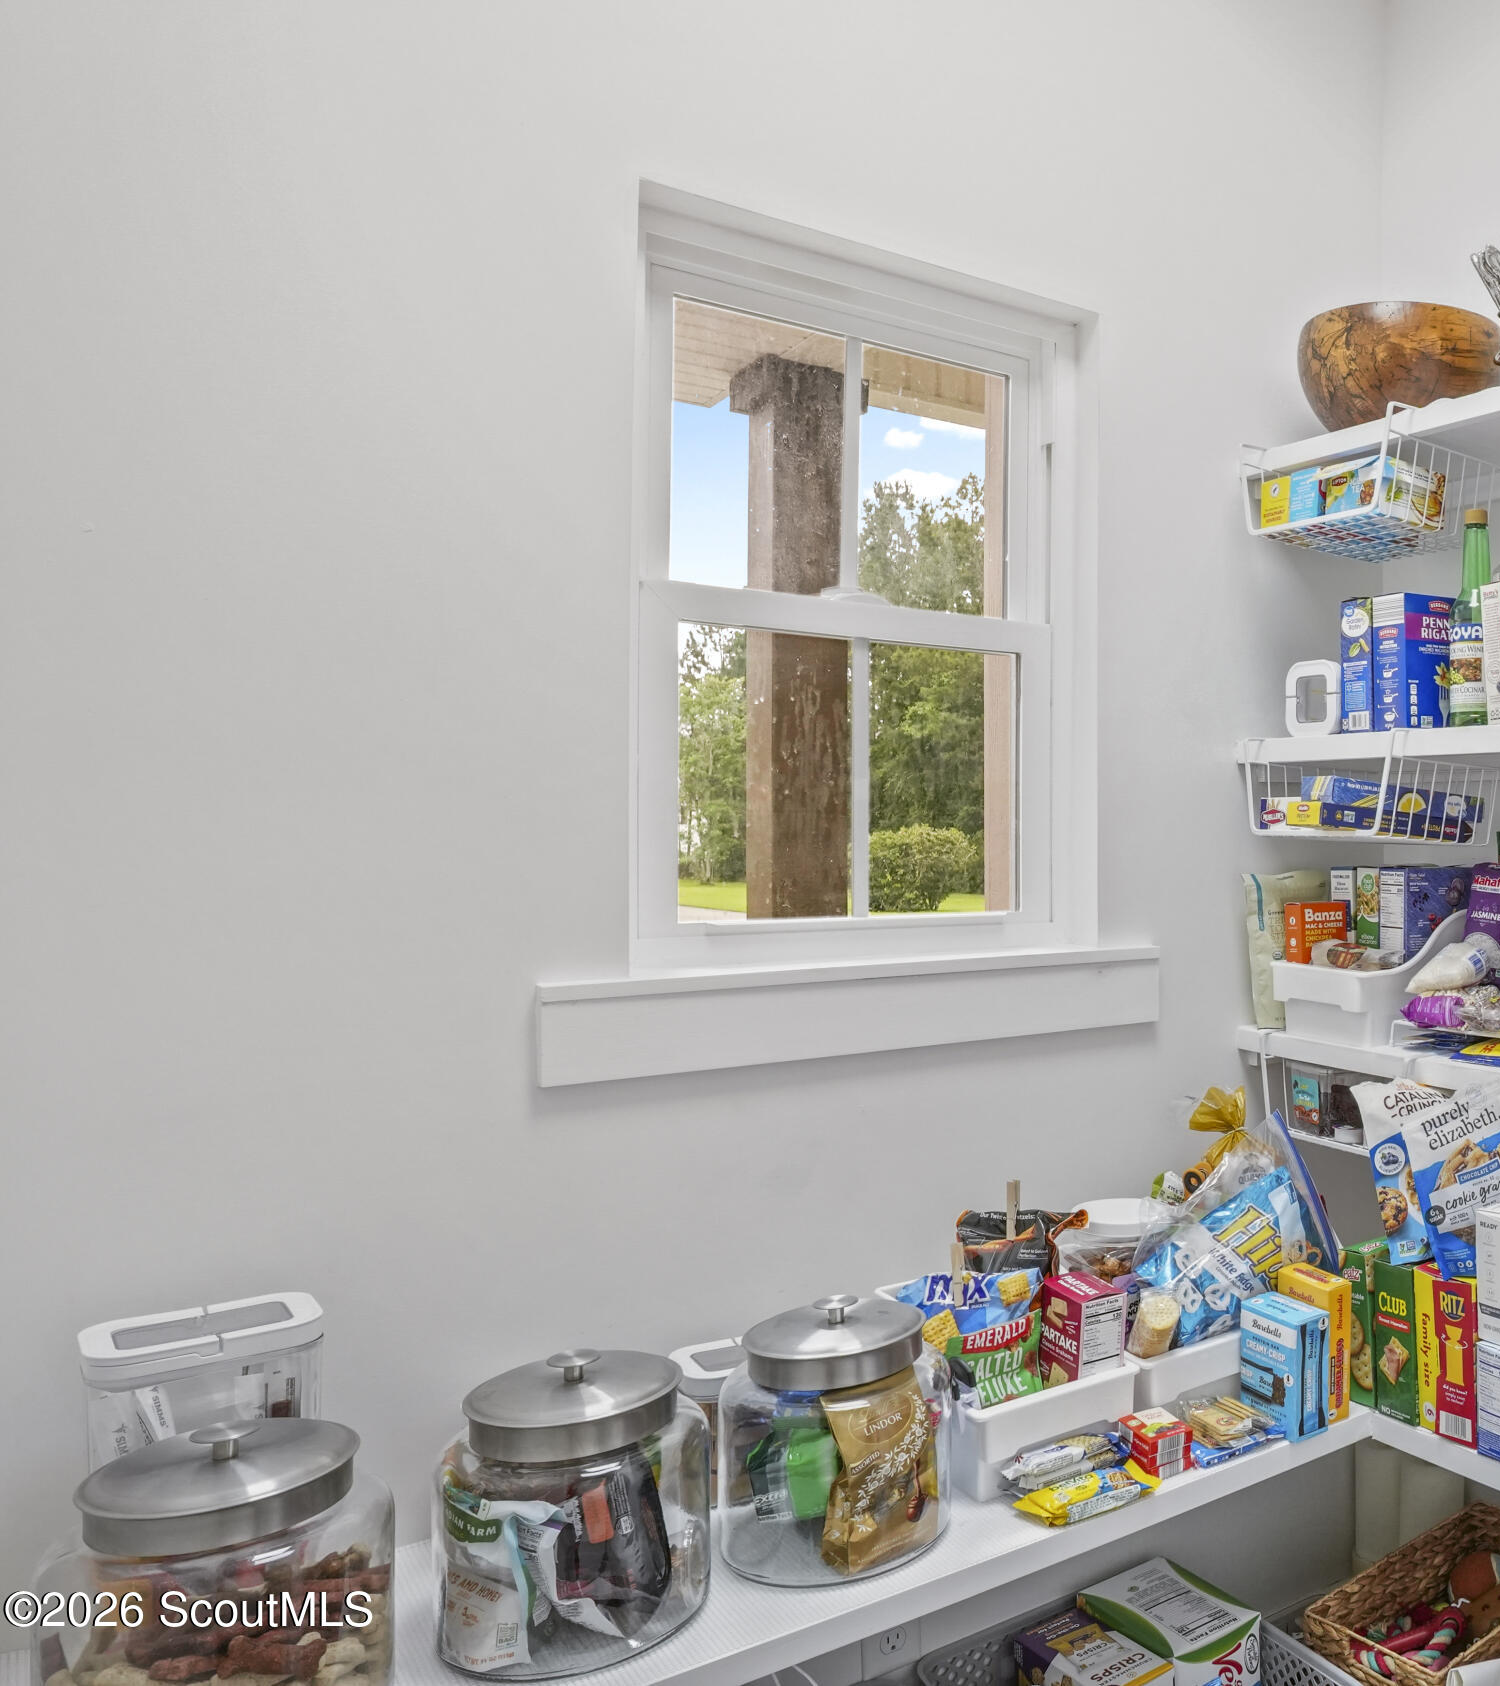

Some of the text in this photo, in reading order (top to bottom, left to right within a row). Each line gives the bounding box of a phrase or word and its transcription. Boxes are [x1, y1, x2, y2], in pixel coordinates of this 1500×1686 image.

[1332, 476, 1347, 486] LIPTON
[1352, 485, 1365, 493] TEA
[1423, 616, 1450, 629] PENN
[1421, 627, 1451, 641] RIGAT
[1304, 908, 1343, 922] Banza
[1421, 1101, 1469, 1137] purely
[1460, 1163, 1499, 1183] CHOCOLATE CHIP
[1445, 1189, 1478, 1211] cookie
[980, 1210, 990, 1218] Our
[1429, 1213, 1444, 1223] SUGAR
[1479, 1221, 1498, 1230] READY
[1208, 1248, 1255, 1293] White Fudge
[1061, 1275, 1099, 1296] PARTAKE
[1288, 1287, 1315, 1304] Barebells
[1378, 1291, 1407, 1317] CLUB
[1440, 1292, 1465, 1317] RITZ
[966, 1318, 1027, 1350] EMERALD
[1041, 1322, 1078, 1355] PARTAKE
[1252, 1318, 1282, 1339] Barebells
[1042, 1338, 1055, 1351] Classic
[1246, 1339, 1286, 1362] CREAMY CRISP
[1420, 1313, 1433, 1387] family size
[978, 1370, 1028, 1408] ELUXE
[152, 1394, 168, 1428] SIMMS
[1381, 1404, 1391, 1415] NO
[863, 1411, 904, 1437] LINDOR
[850, 1451, 881, 1475] ASSORTED
[467, 1523, 498, 1536] FARM
[458, 1576, 503, 1604] AND HONEY
[1189, 1617, 1238, 1642] Nutrition Facts
[1076, 1642, 1107, 1657] CRISPS
[1090, 1652, 1145, 1682] CRISPS
